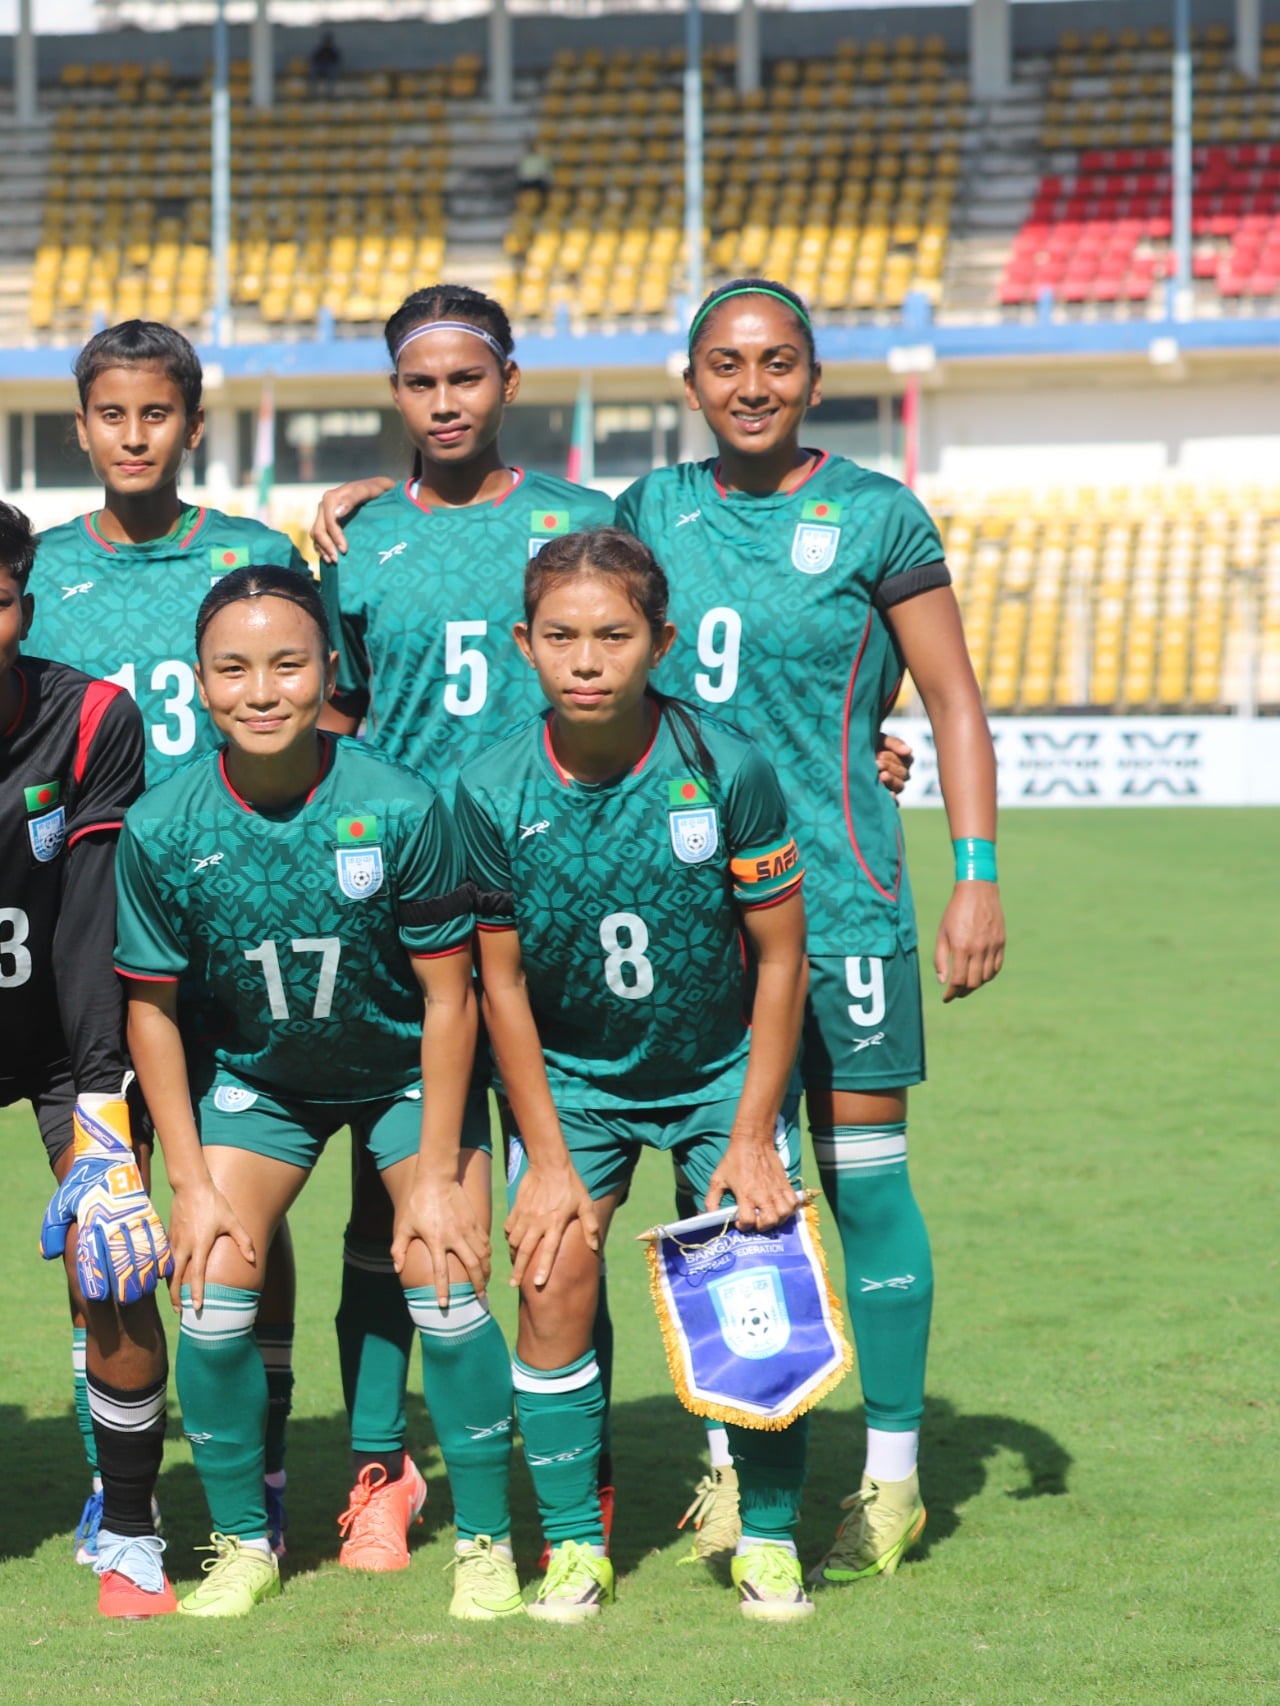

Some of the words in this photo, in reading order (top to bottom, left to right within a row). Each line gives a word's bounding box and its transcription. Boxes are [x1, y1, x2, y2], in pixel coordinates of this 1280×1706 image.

[443, 620, 488, 716] 5
[694, 606, 742, 703] 9
[756, 845, 798, 882] SAF
[244, 937, 341, 1020] 17
[599, 911, 655, 1000] 8
[845, 955, 886, 1027] 9
